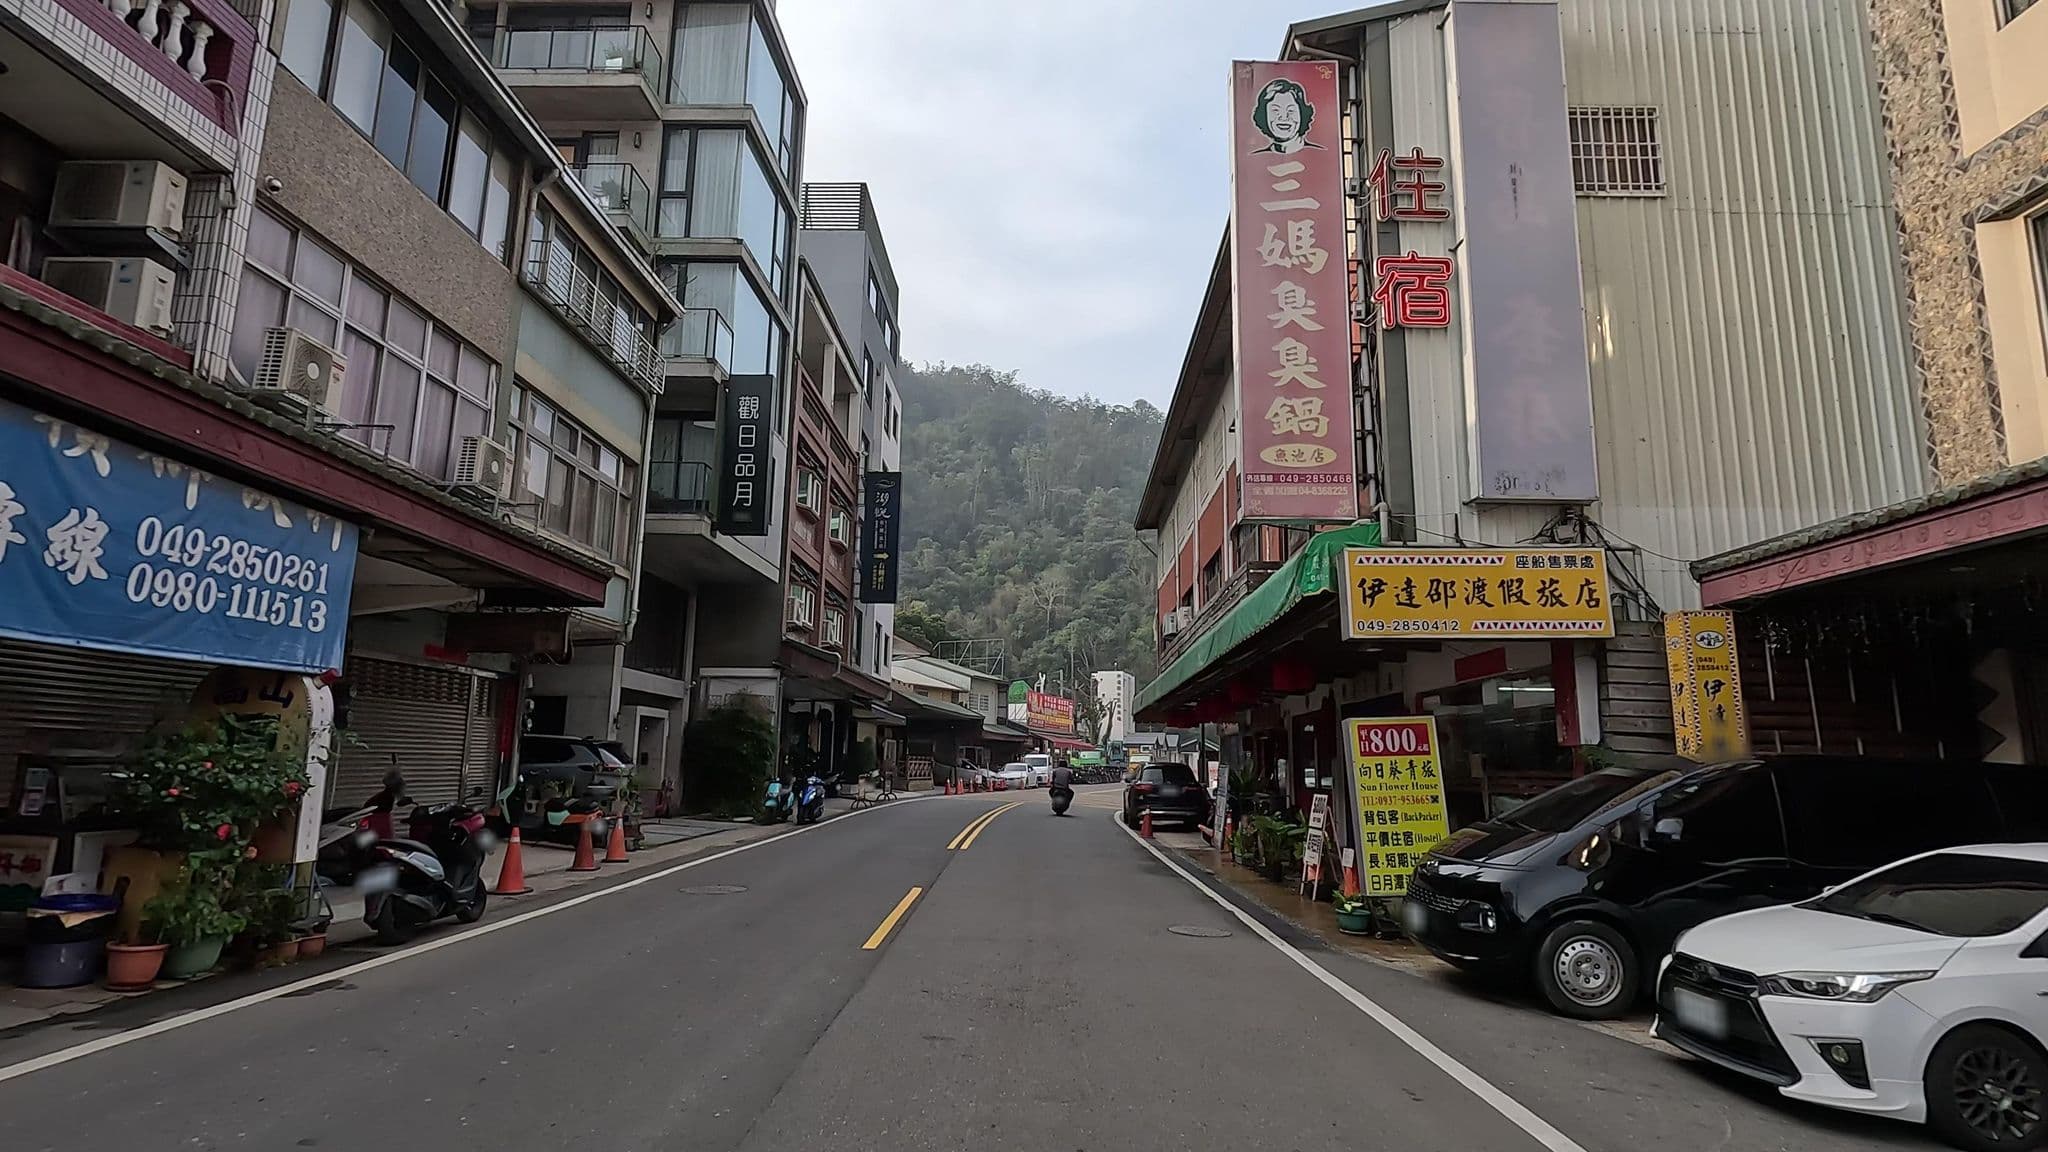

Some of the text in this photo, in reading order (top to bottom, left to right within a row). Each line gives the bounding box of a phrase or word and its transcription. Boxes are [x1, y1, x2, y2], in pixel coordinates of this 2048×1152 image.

[1369, 147, 1453, 329] 住宿
[1257, 161, 1329, 438] 三媽臭臭鍋
[733, 396, 760, 507] 觀日品月
[1274, 448, 1324, 463] 魚池店
[1279, 474, 1352, 483] 049-2850468
[137, 517, 328, 595] 049-2850261
[1515, 555, 1595, 569] 座船售票處
[127, 563, 327, 632] 0980-111513
[1357, 577, 1601, 610] 伊達邵渡假旅店
[1357, 620, 1460, 632] 049-2850412
[1369, 727, 1417, 753] 800
[1359, 759, 1436, 780] 向日葵青旅
[1360, 781, 1439, 791] Sun Flower House
[1363, 810, 1442, 826] 背包客 (BackPacker)
[1366, 830, 1442, 847] 平價住宿 (Hostel)
